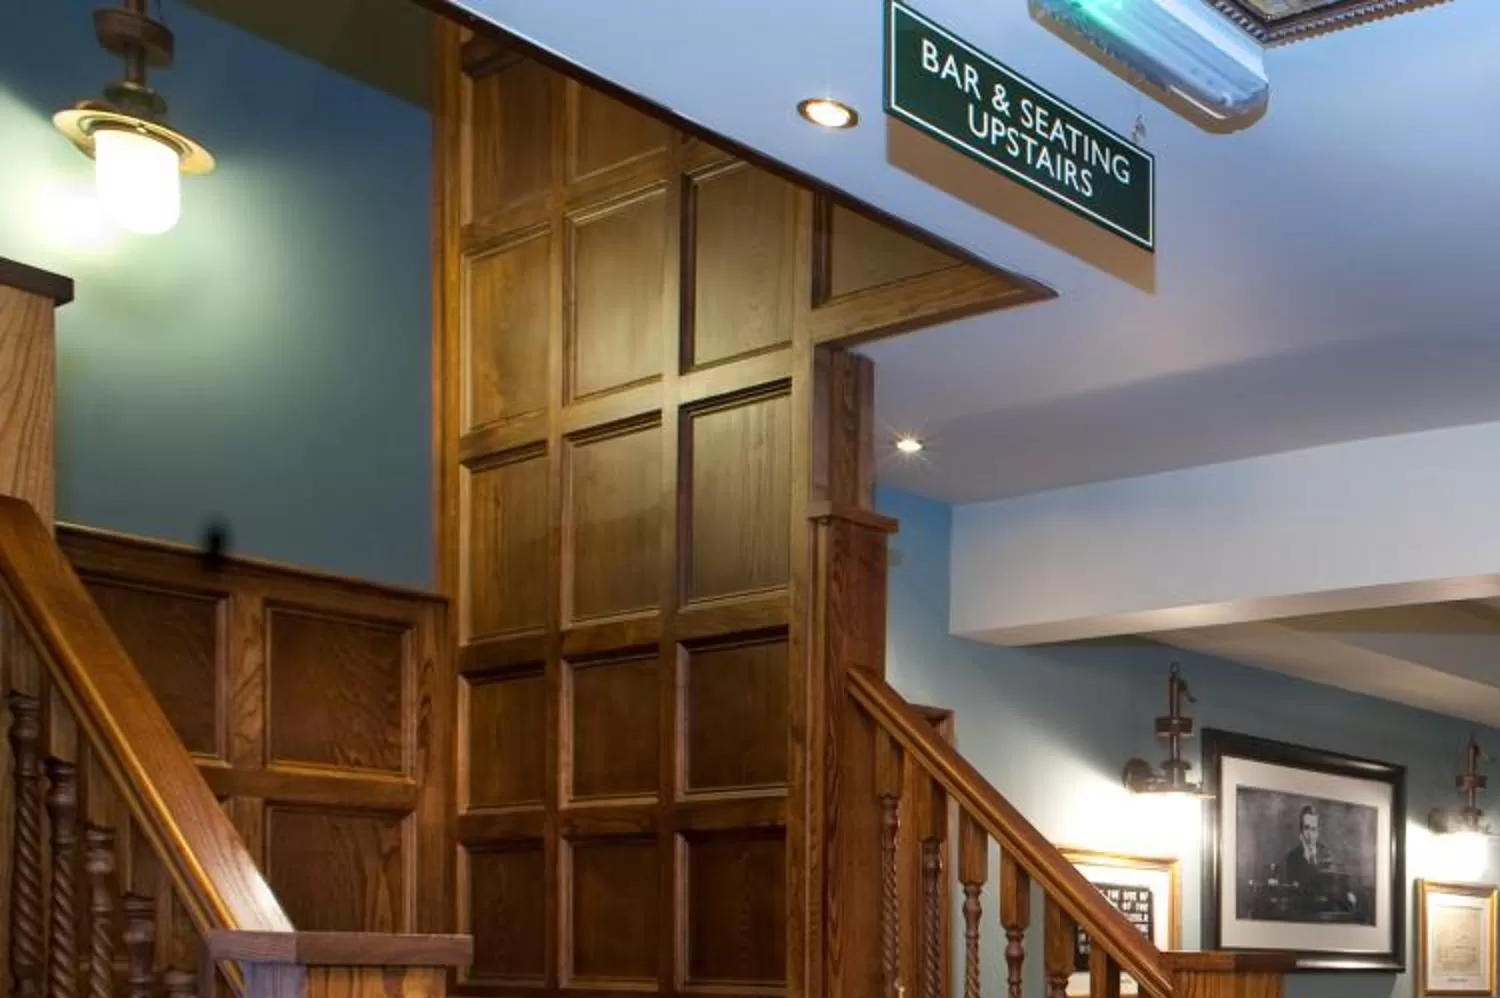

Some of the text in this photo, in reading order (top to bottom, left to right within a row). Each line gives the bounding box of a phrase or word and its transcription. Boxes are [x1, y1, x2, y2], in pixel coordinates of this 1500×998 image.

[920, 37, 1130, 184] BAR & SEATING
[967, 103, 1094, 198] UPSTAIRS
